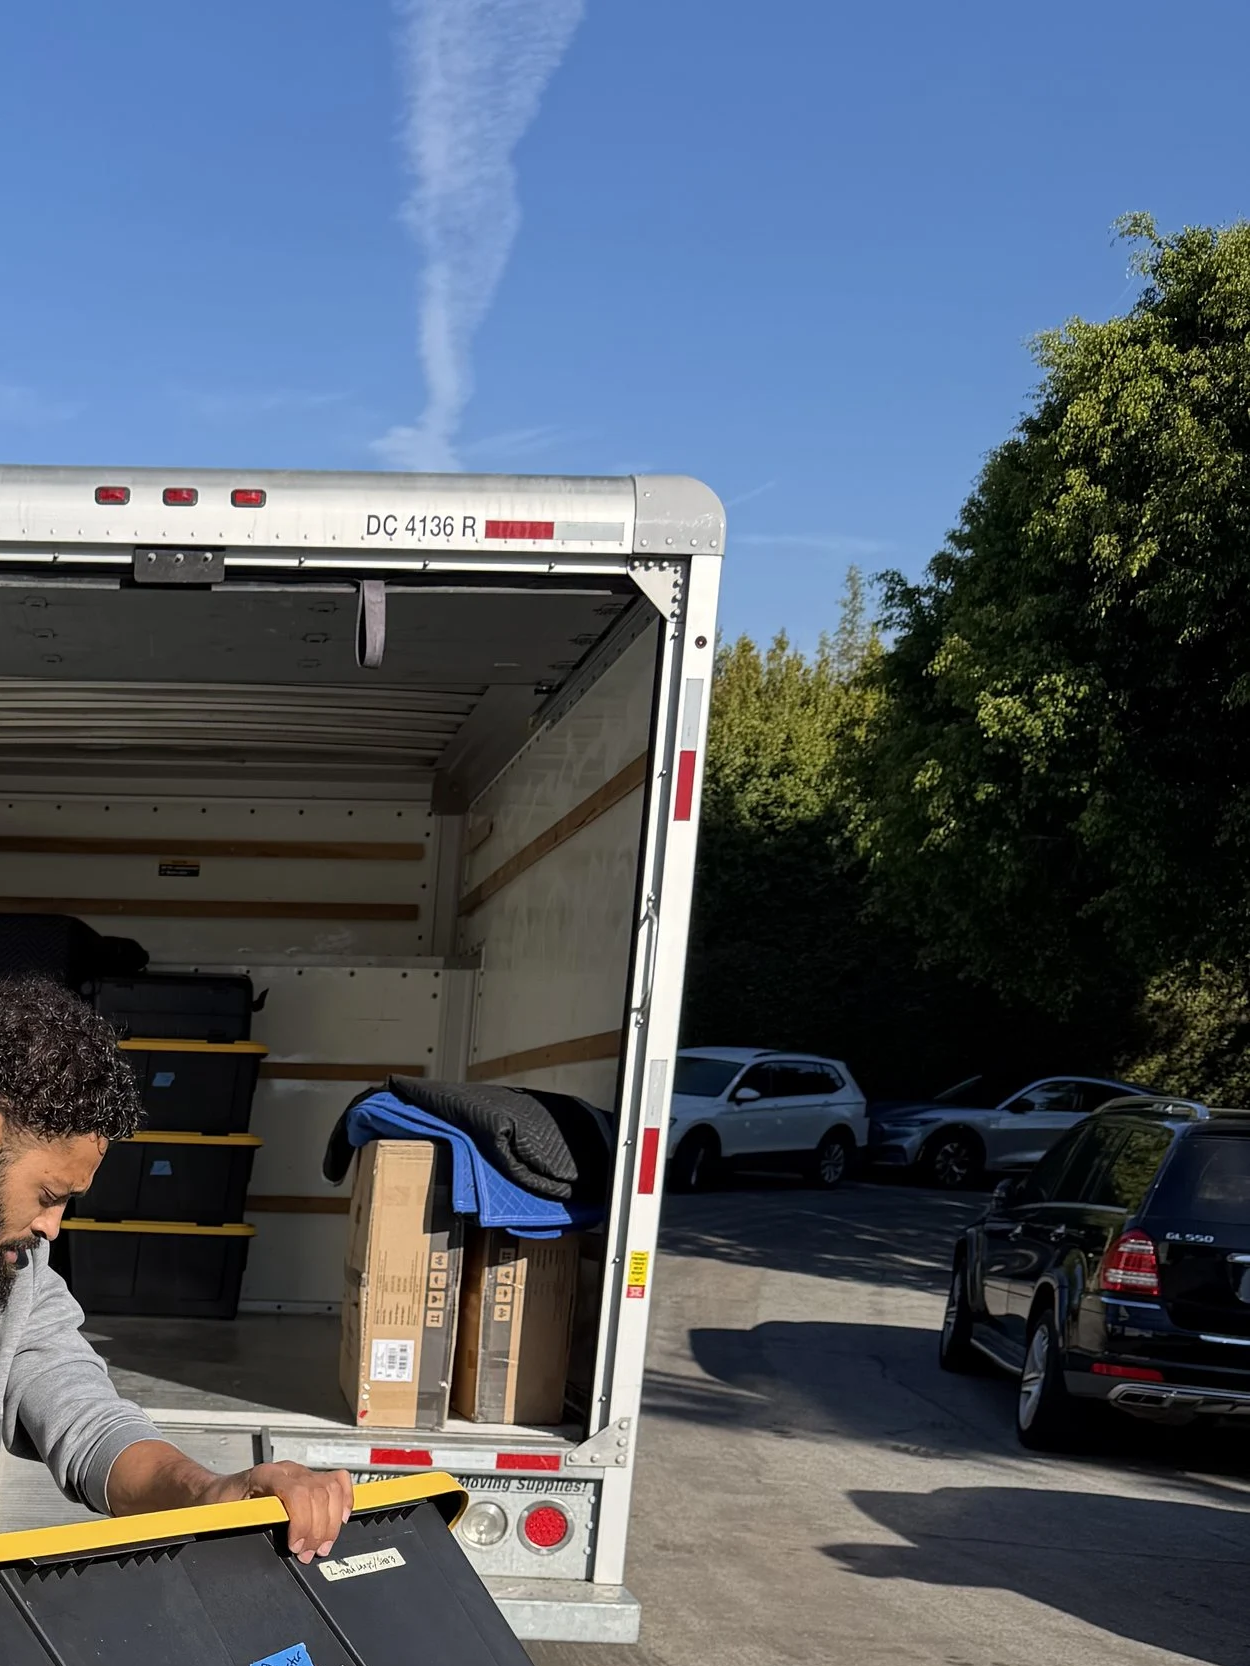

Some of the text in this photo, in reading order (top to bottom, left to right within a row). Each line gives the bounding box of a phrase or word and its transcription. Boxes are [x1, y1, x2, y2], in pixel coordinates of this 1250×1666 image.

[366, 514, 476, 537] DC 4136 R
